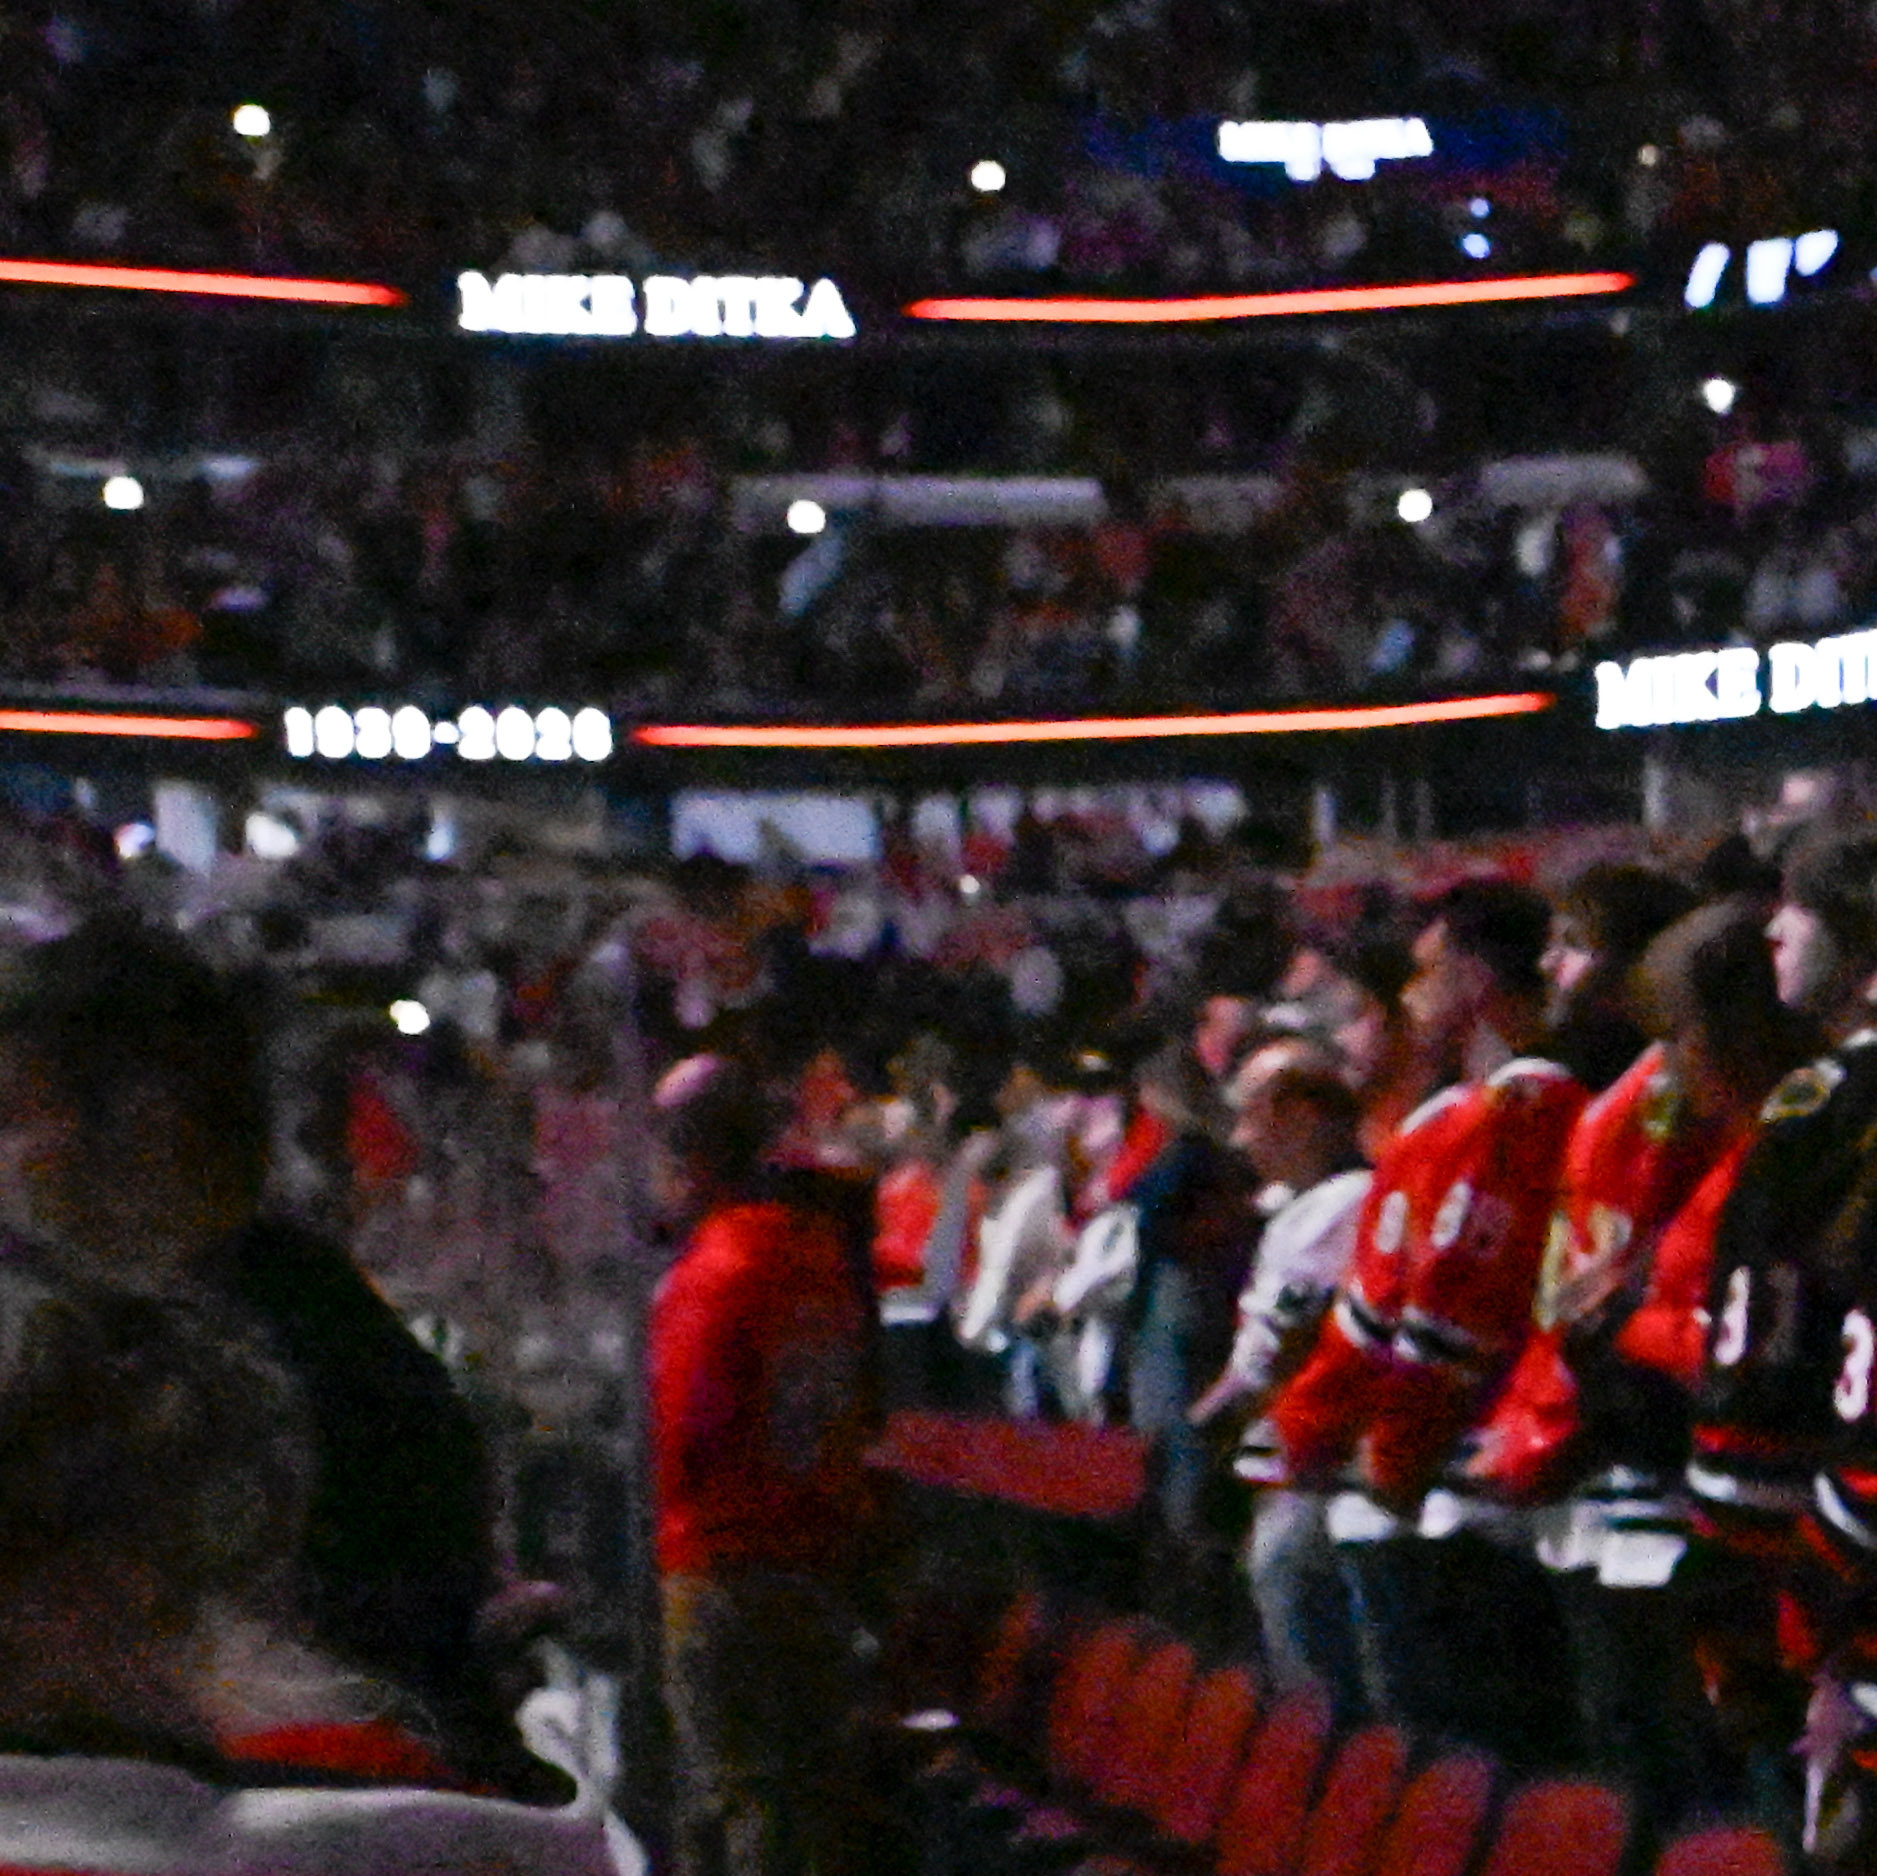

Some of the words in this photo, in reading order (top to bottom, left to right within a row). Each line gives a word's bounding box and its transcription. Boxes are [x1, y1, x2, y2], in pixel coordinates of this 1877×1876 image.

[457, 269, 639, 337] MIKE
[641, 273, 857, 339] DITKA
[1594, 646, 1762, 730] MIKE
